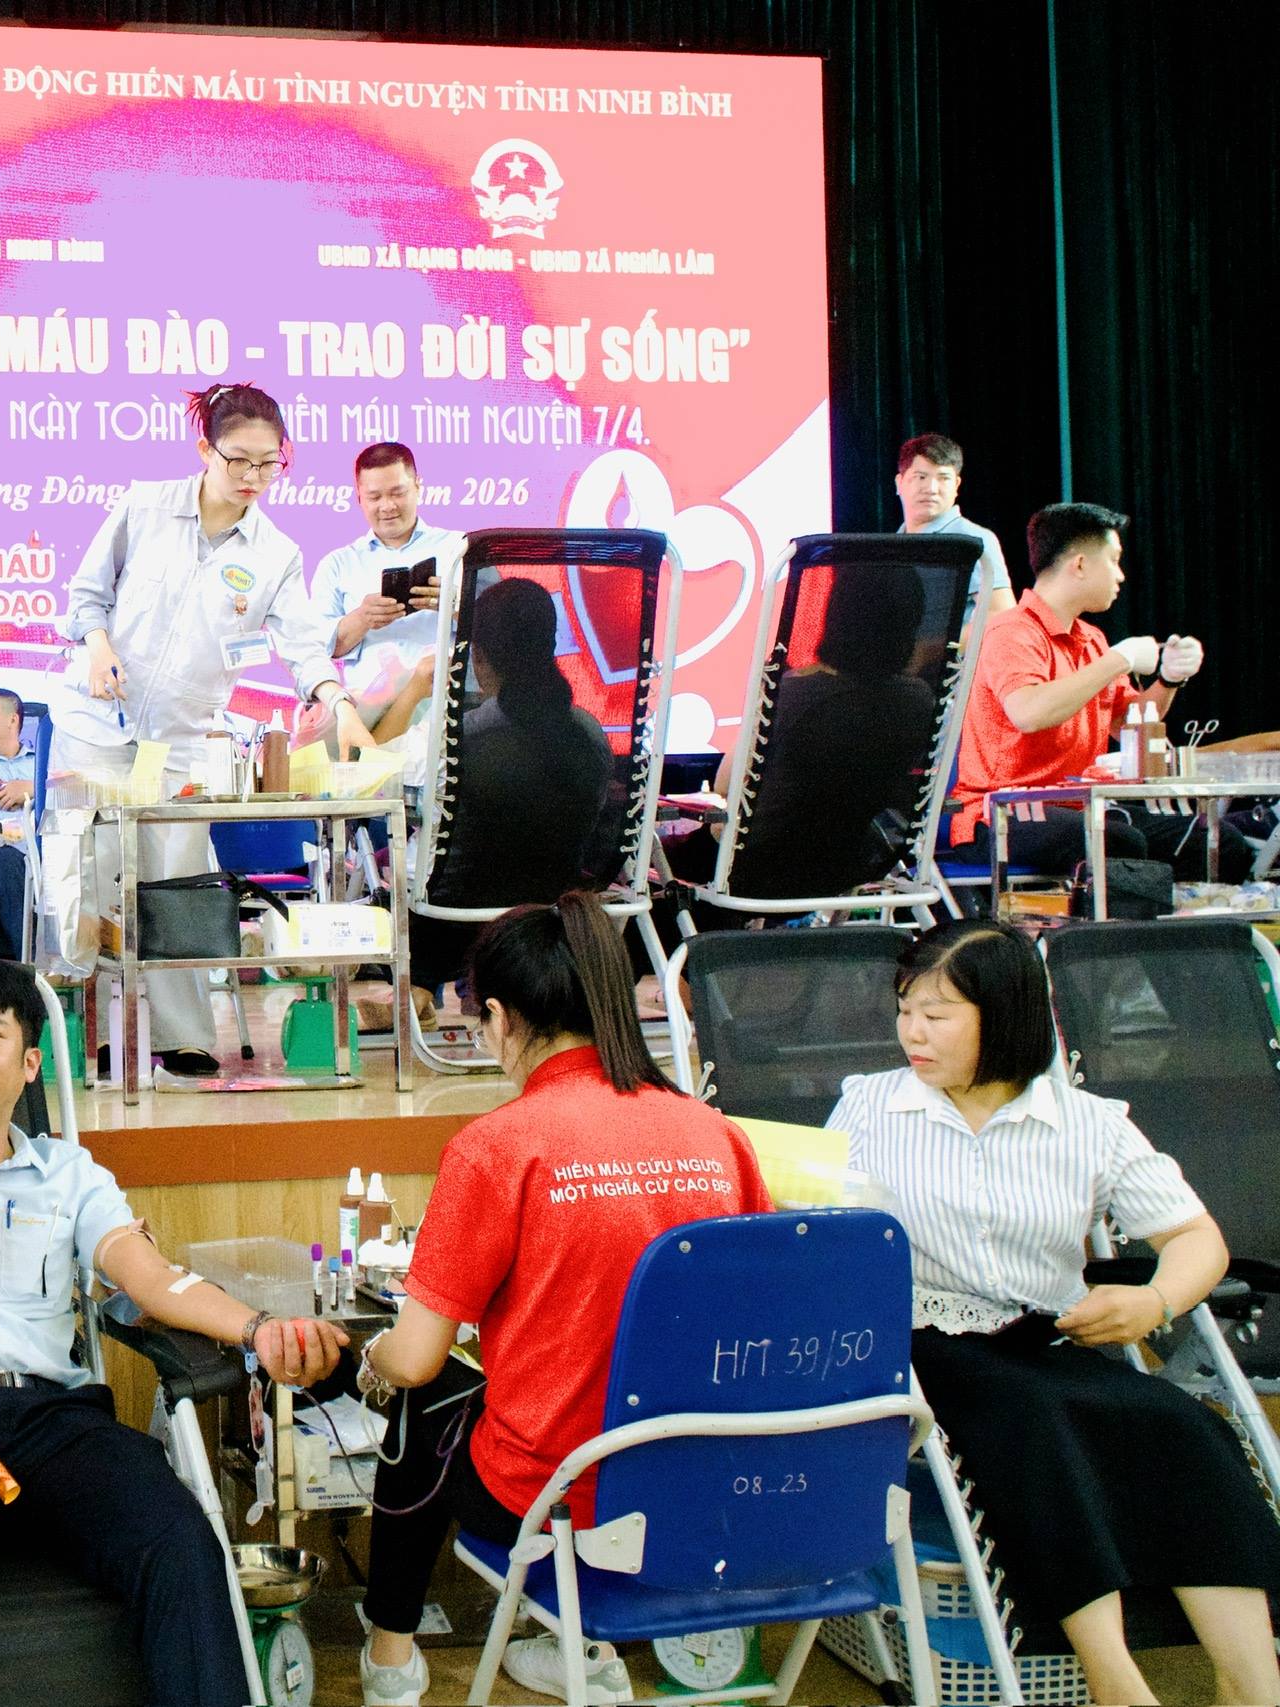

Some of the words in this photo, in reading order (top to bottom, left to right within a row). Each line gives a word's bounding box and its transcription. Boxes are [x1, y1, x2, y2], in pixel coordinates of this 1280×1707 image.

[2, 65, 98, 100] ĐỘNG
[105, 66, 185, 98] HIẾN
[192, 69, 266, 102] MÁU
[273, 71, 351, 104] TÌNH
[358, 80, 487, 116] NGUYỆN
[494, 79, 570, 113] TỈNH
[576, 88, 653, 115] NINH
[659, 85, 732, 118] BÌNH
[124, 309, 229, 376] ĐÀO
[278, 320, 405, 379] TRAO
[420, 314, 507, 381] ĐỜI
[521, 317, 591, 391] SỰ
[9, 392, 82, 441] NGÀY
[93, 393, 186, 441] TOÀN
[341, 396, 400, 443] MÁU
[410, 397, 471, 444] TÌNH
[483, 398, 582, 451] NGUYỆN
[267, 475, 354, 513] tháng
[459, 477, 529, 506] 2026
[549, 1183, 588, 1204] MỘT
[591, 1179, 643, 1198] NGHĨA
[673, 1177, 709, 1193] CAO
[711, 1179, 732, 1196] ĐẸP
[554, 1160, 595, 1182] HIẾN
[597, 1160, 633, 1177] MÁU
[636, 1158, 673, 1175] CỨU
[784, 1329, 874, 1381] 39/50
